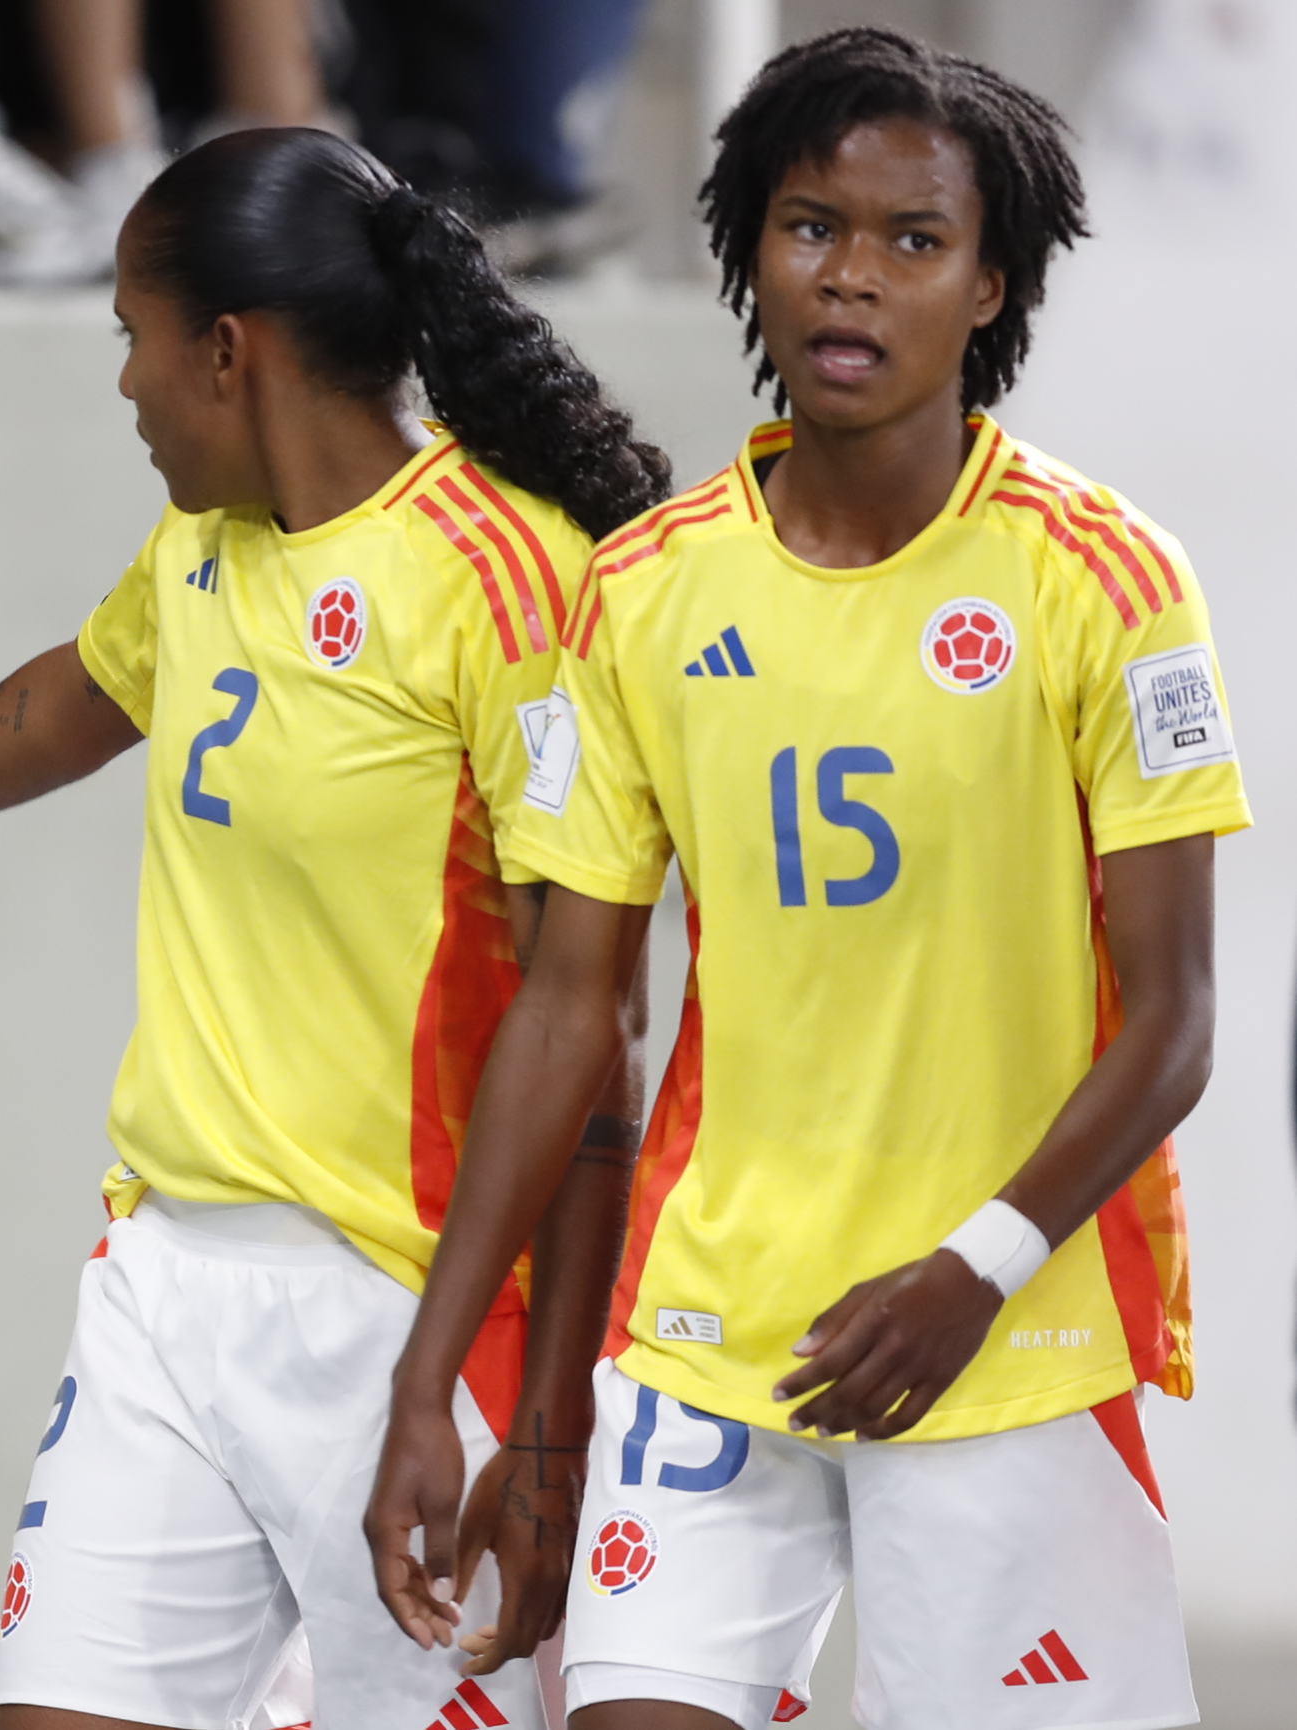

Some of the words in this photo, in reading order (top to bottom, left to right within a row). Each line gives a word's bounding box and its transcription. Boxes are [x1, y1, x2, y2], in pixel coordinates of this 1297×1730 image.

[1150, 664, 1206, 692] FOOTBALL
[1153, 680, 1212, 713] UNITES
[1155, 714, 1177, 732] the
[1178, 701, 1219, 727] World
[183, 668, 258, 826] 2
[1175, 730, 1205, 748] FIFA
[772, 747, 900, 907] 15
[619, 1384, 751, 1493] 15
